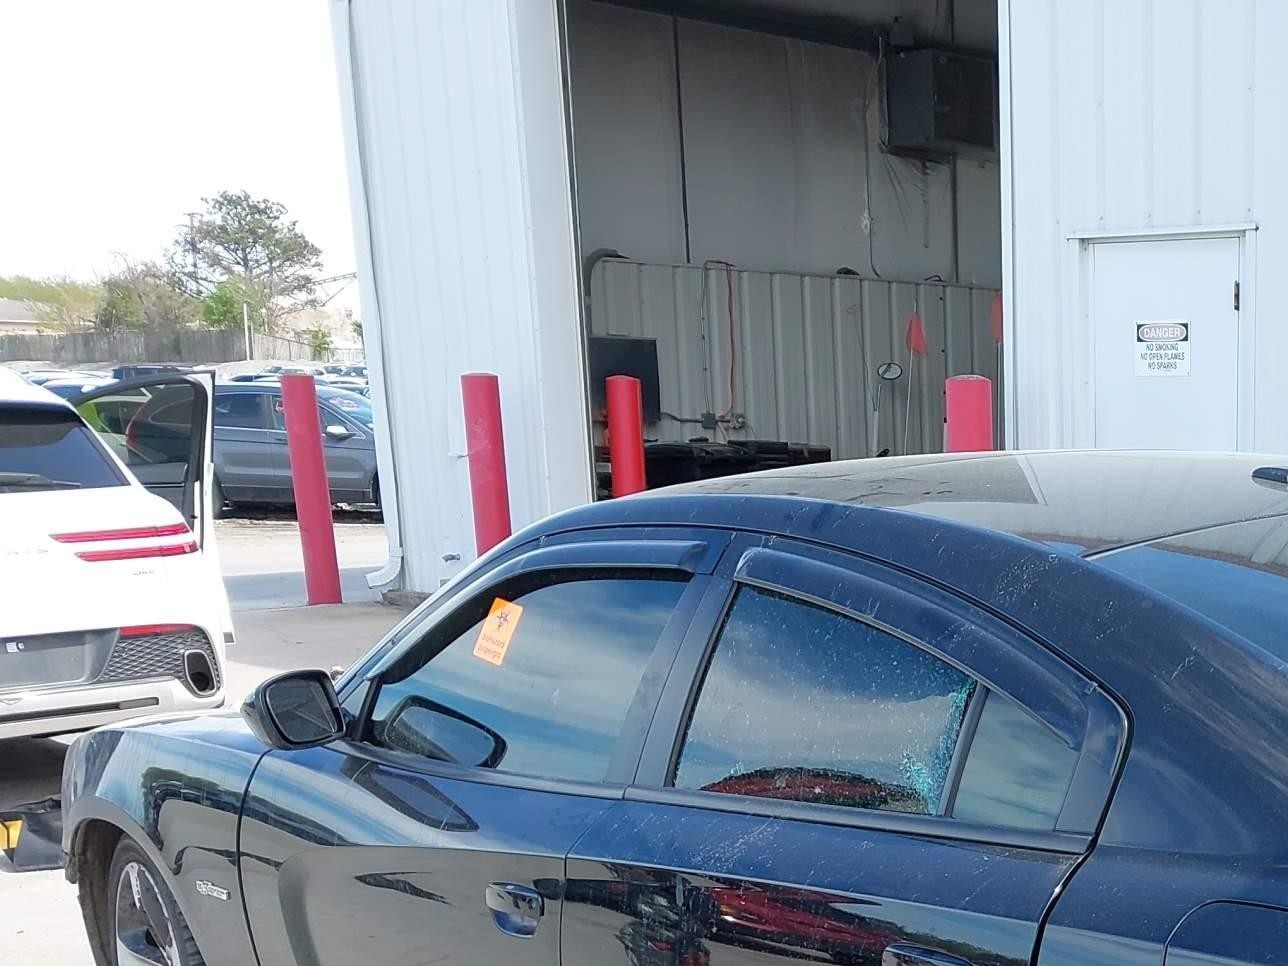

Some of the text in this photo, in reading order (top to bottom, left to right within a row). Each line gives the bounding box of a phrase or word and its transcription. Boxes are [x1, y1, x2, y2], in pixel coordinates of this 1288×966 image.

[1143, 327, 1181, 338] DANGER
[1146, 343, 1178, 351] NO SMOKING
[1140, 352, 1185, 360] NO OPEN FLAMES
[1148, 361, 1177, 370] NO SPARKS
